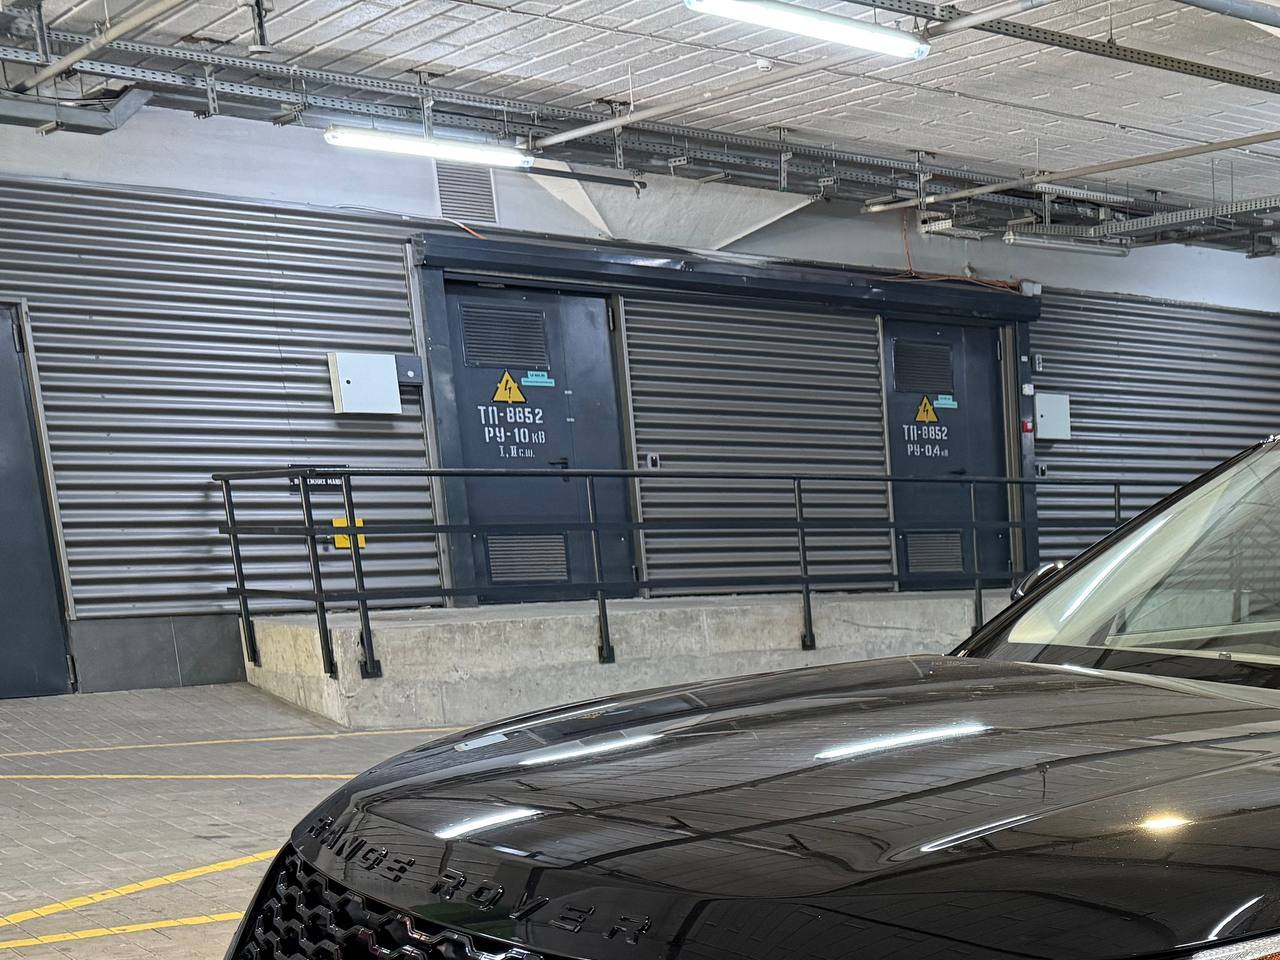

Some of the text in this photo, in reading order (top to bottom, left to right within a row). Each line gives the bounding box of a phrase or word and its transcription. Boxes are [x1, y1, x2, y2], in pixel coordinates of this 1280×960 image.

[477, 405, 544, 425] ТП-8852
[484, 426, 529, 443] РУ-10
[902, 424, 948, 441] ТП-8852
[307, 815, 652, 945] RANGE ROVER
